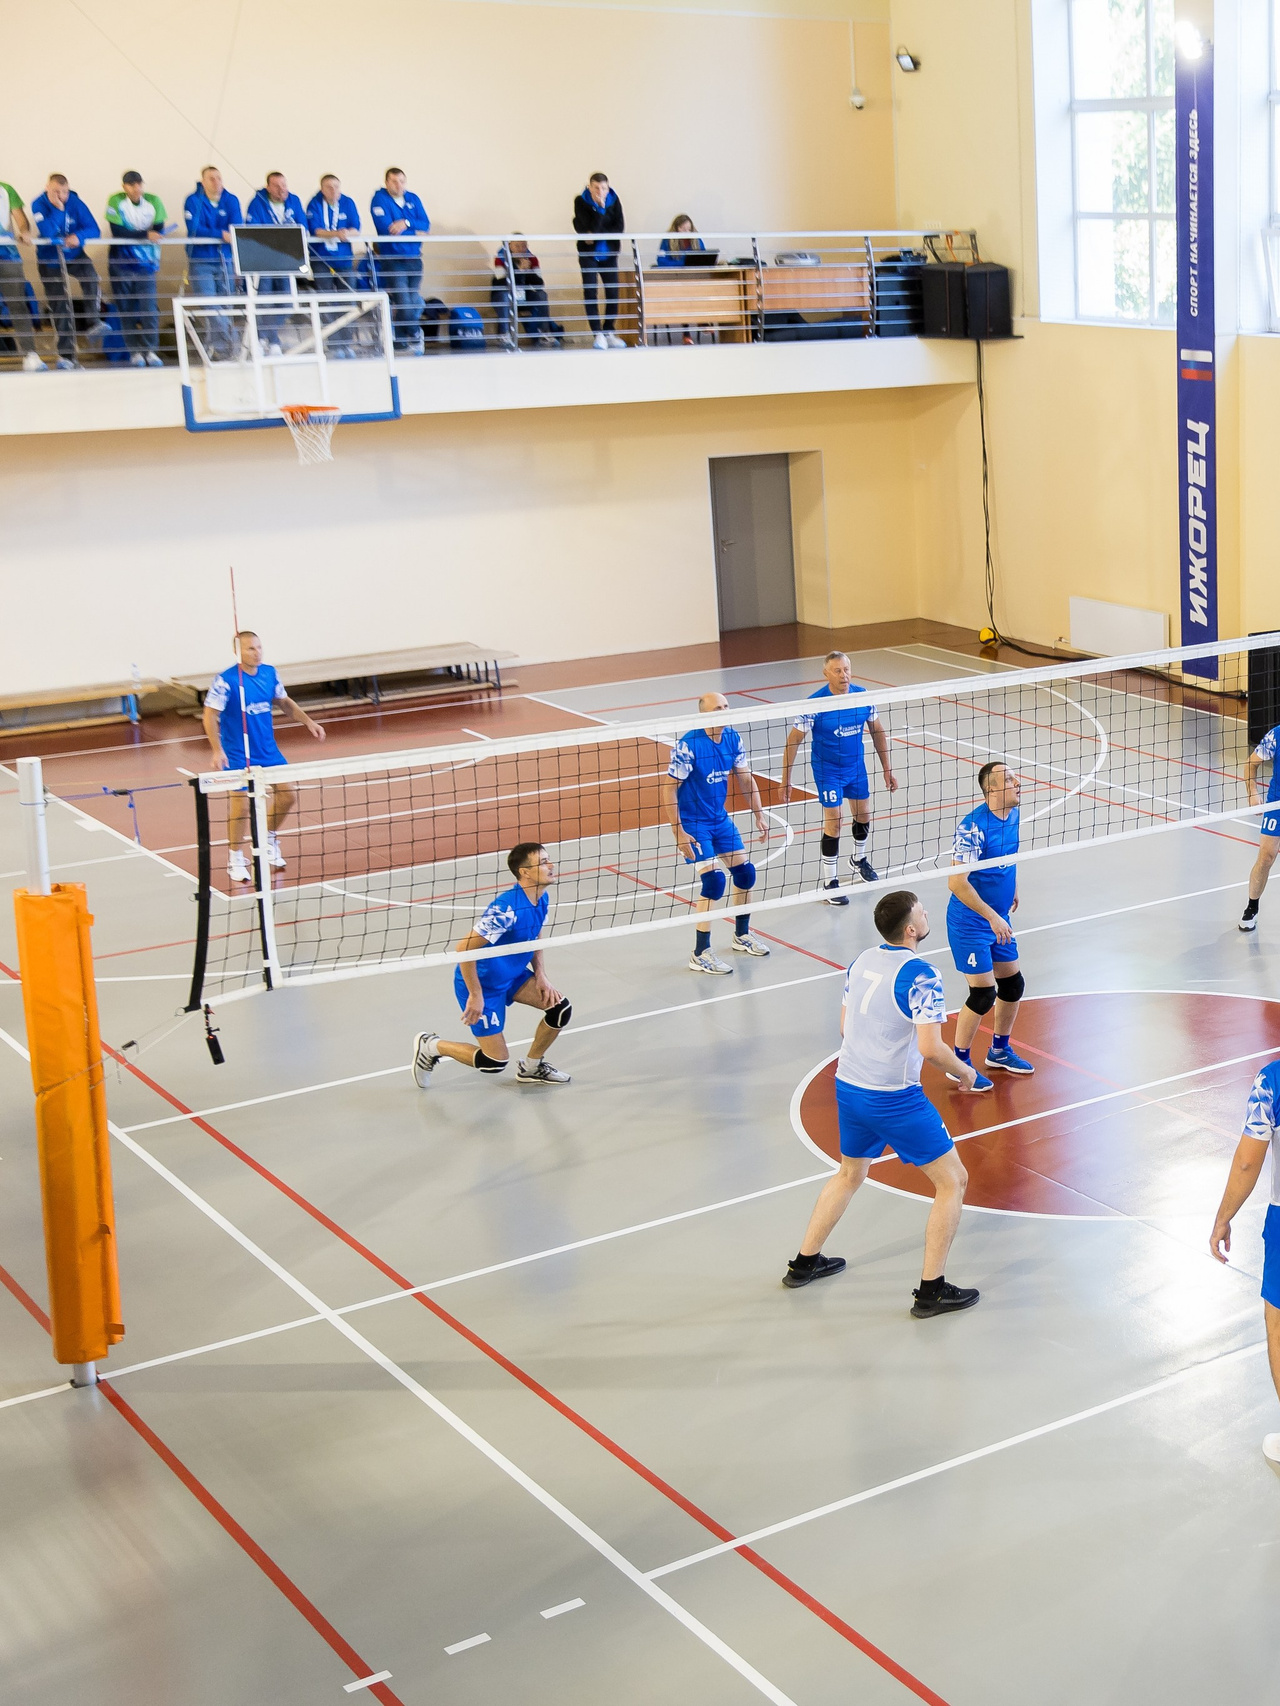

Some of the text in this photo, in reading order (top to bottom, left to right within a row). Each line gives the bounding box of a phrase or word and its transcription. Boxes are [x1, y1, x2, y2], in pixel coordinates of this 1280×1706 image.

[1189, 108, 1200, 318] СПОРТ НАЧИНАЕТСЯ ЗДЕСЬ
[1186, 418, 1210, 628] ИЖОРЕЦ
[822, 790, 838, 803] 16
[1262, 816, 1278, 831] 10
[967, 952, 978, 968] 4
[859, 970, 883, 1015] 7
[480, 1011, 500, 1029] 14
